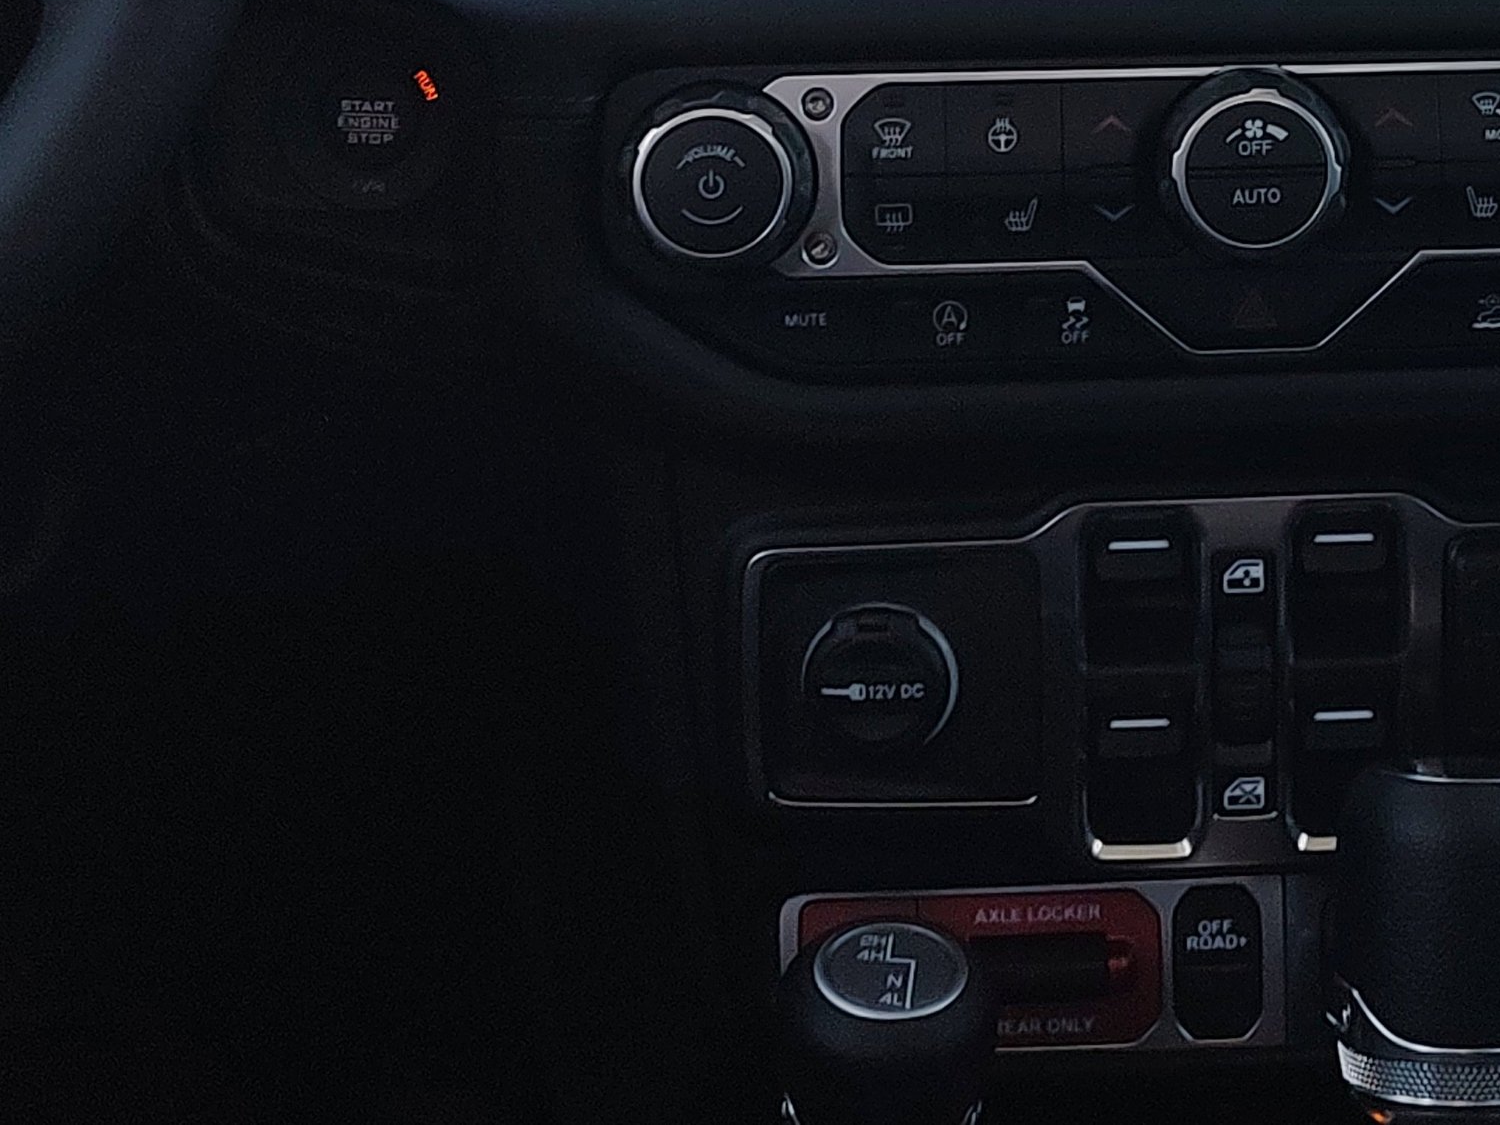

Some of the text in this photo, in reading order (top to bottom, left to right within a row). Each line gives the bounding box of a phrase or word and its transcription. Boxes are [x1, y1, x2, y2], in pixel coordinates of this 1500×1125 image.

[341, 100, 395, 112] START
[338, 116, 400, 130] ENGINE
[347, 133, 394, 145] STOP
[684, 144, 736, 162] VOLUME
[871, 145, 913, 160] FRONT
[1238, 140, 1273, 157] OFF
[1232, 188, 1283, 205] AUTO
[784, 312, 827, 328] MUTE
[936, 332, 965, 346] OFF
[1061, 330, 1089, 344] OFF
[868, 683, 925, 699] 12V DC
[974, 906, 1021, 924] AXLE
[1198, 919, 1235, 936] OFF
[886, 974, 904, 990] N
[1046, 1016, 1096, 1035] ONLY
